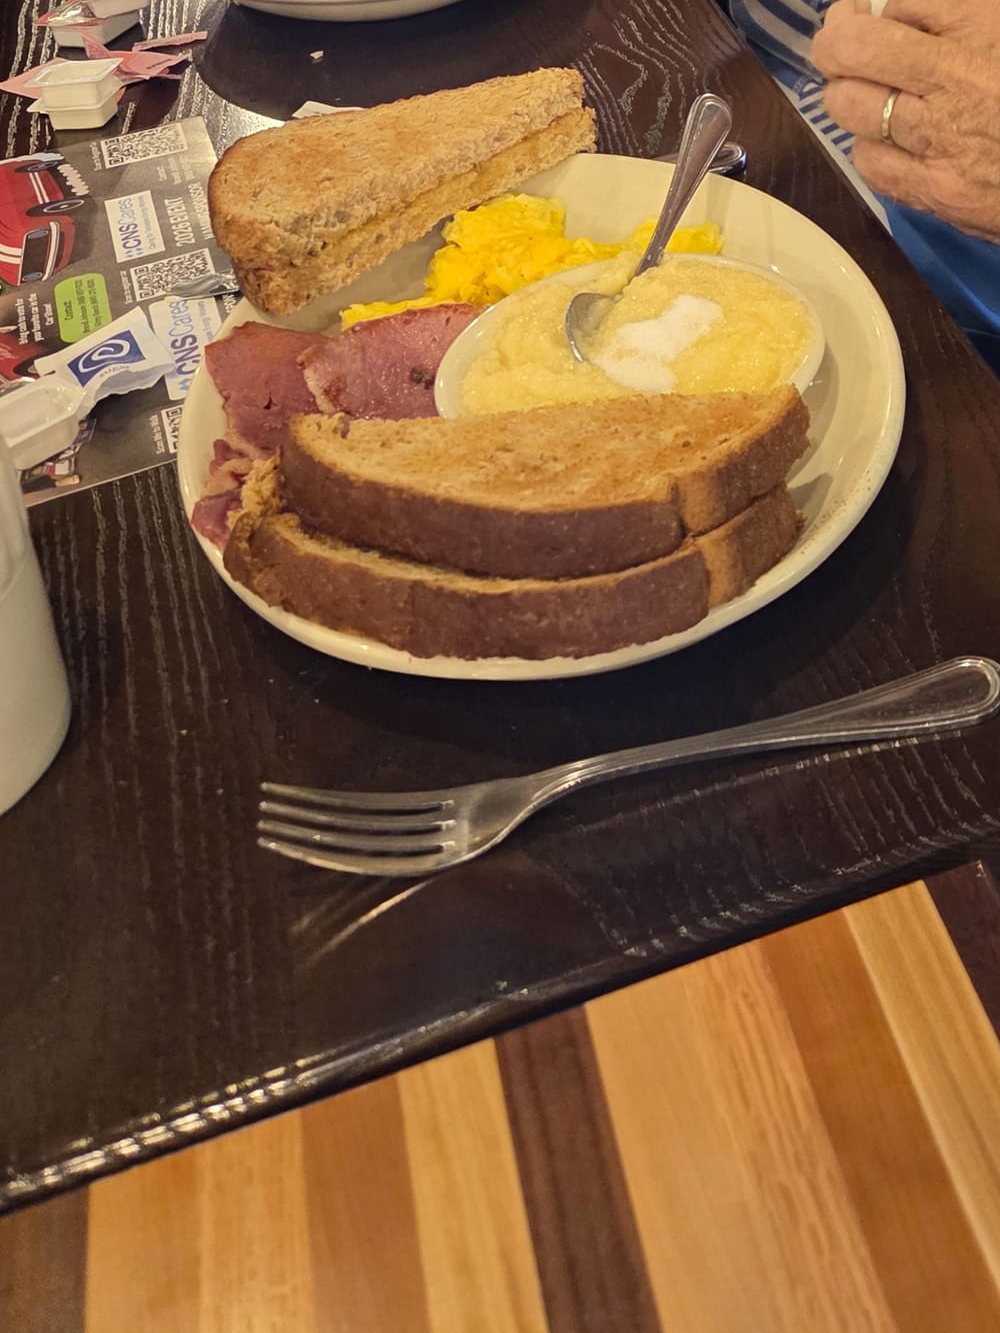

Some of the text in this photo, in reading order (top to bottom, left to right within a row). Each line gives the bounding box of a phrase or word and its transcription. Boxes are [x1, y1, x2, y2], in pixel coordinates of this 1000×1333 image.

[164, 197, 188, 223] EVENT
[172, 222, 195, 247] 2026
[168, 299, 201, 376] CNSCares
